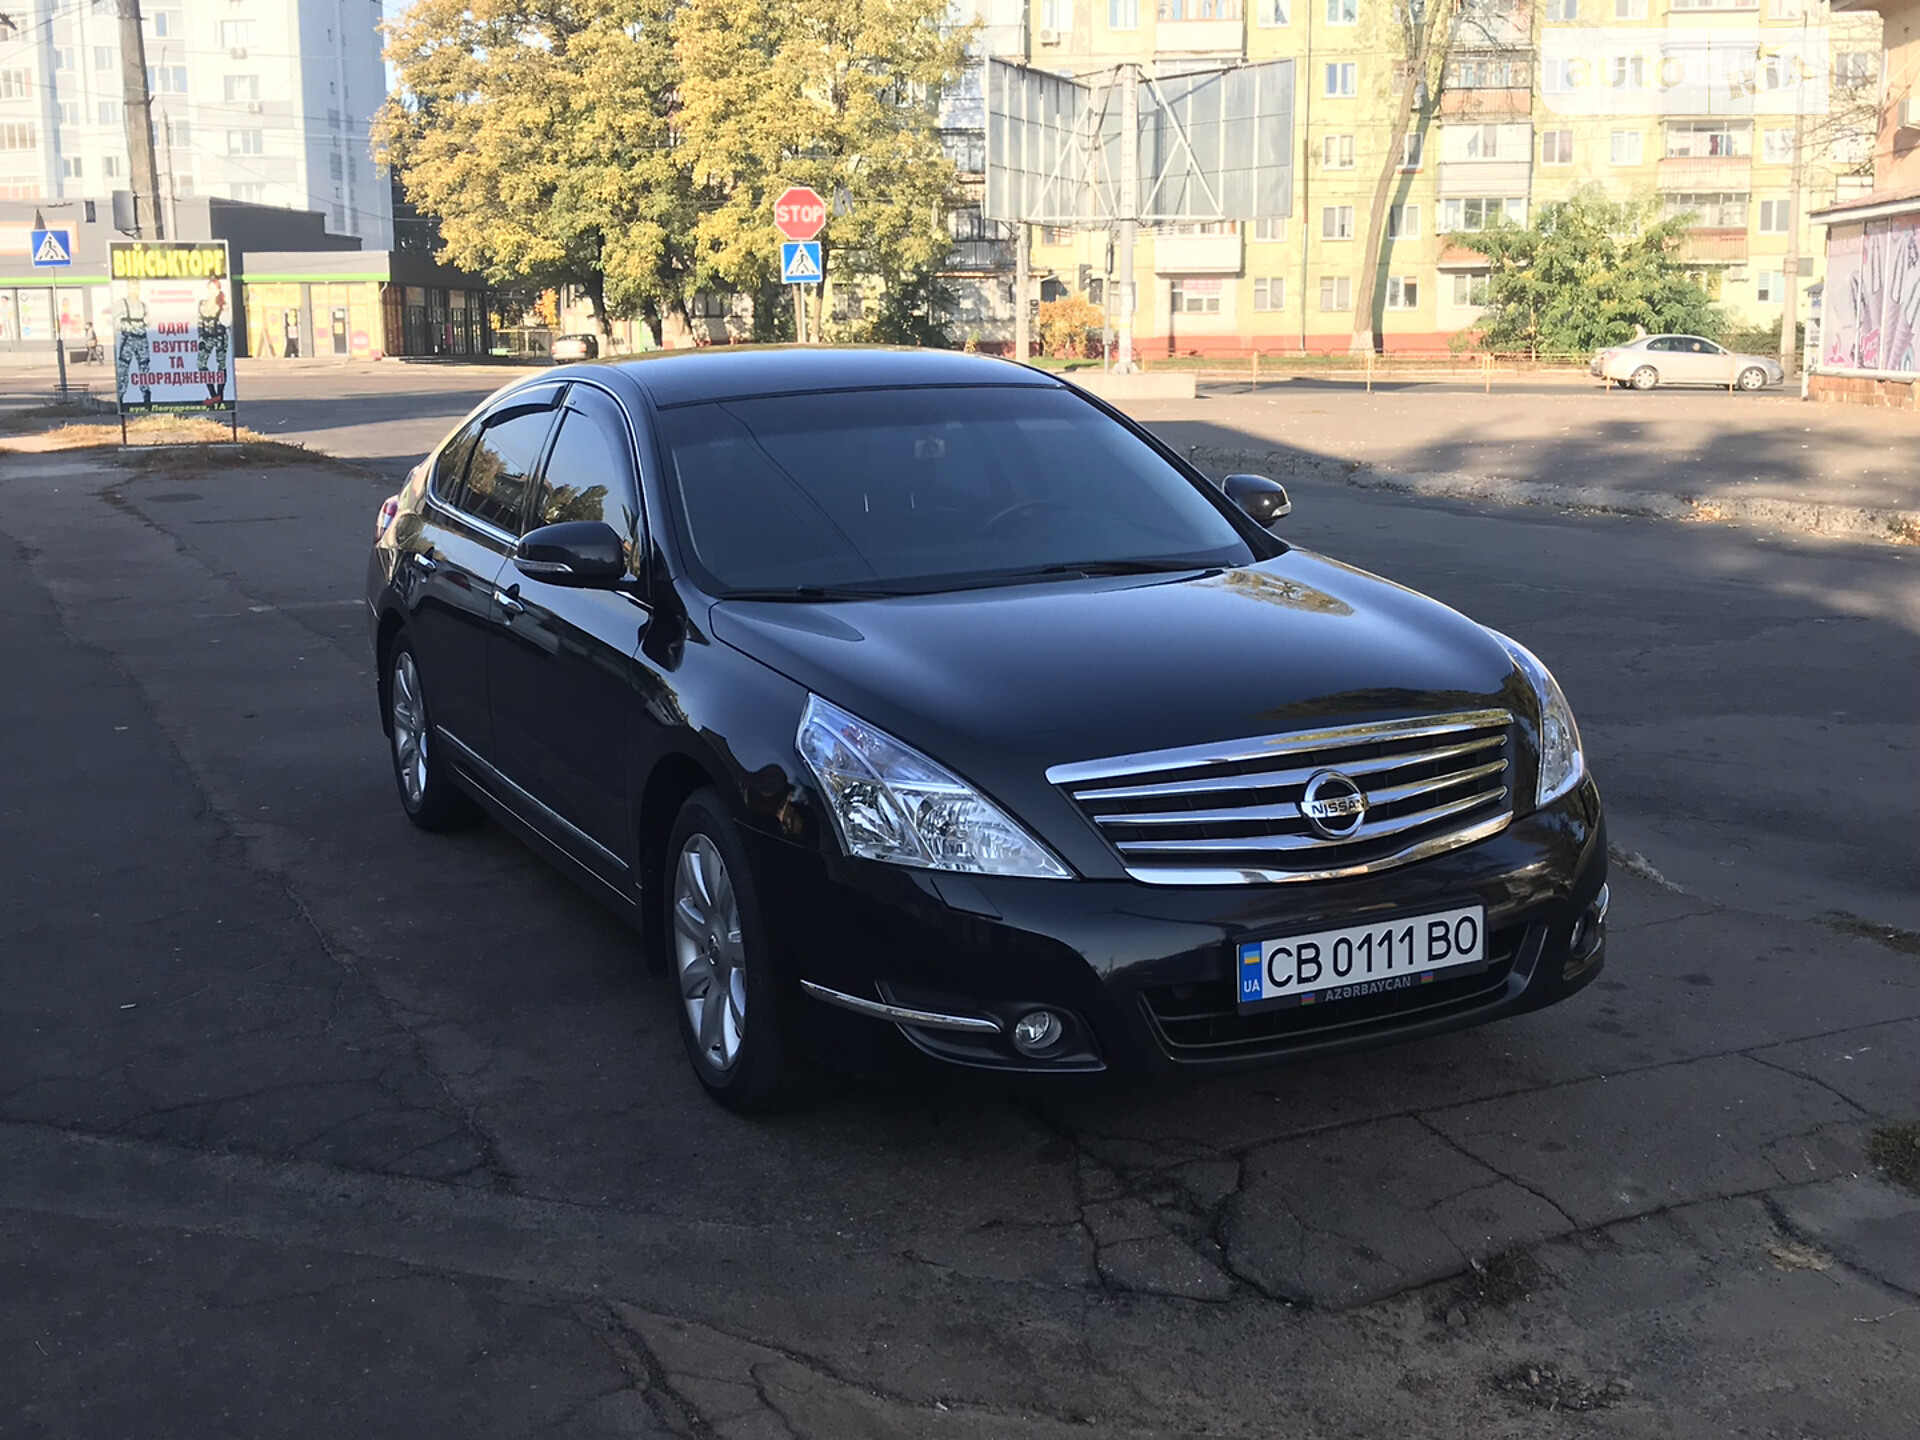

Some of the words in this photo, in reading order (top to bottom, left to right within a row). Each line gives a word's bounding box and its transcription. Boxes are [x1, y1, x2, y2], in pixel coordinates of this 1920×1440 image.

[777, 205, 823, 222] STOP
[113, 243, 225, 277] ВІЙСЬКТОРГ
[157, 322, 190, 335] ОДЯГ
[152, 340, 199, 353] ВЗУТТЯ
[169, 356, 185, 369] ТА
[130, 371, 225, 386] СПОРЯДЖЕННЯ
[1311, 799, 1365, 815] NISSAN
[1267, 942, 1323, 988] CB
[1332, 925, 1415, 977] 0111
[1427, 915, 1478, 962] BO
[1243, 979, 1261, 993] UA
